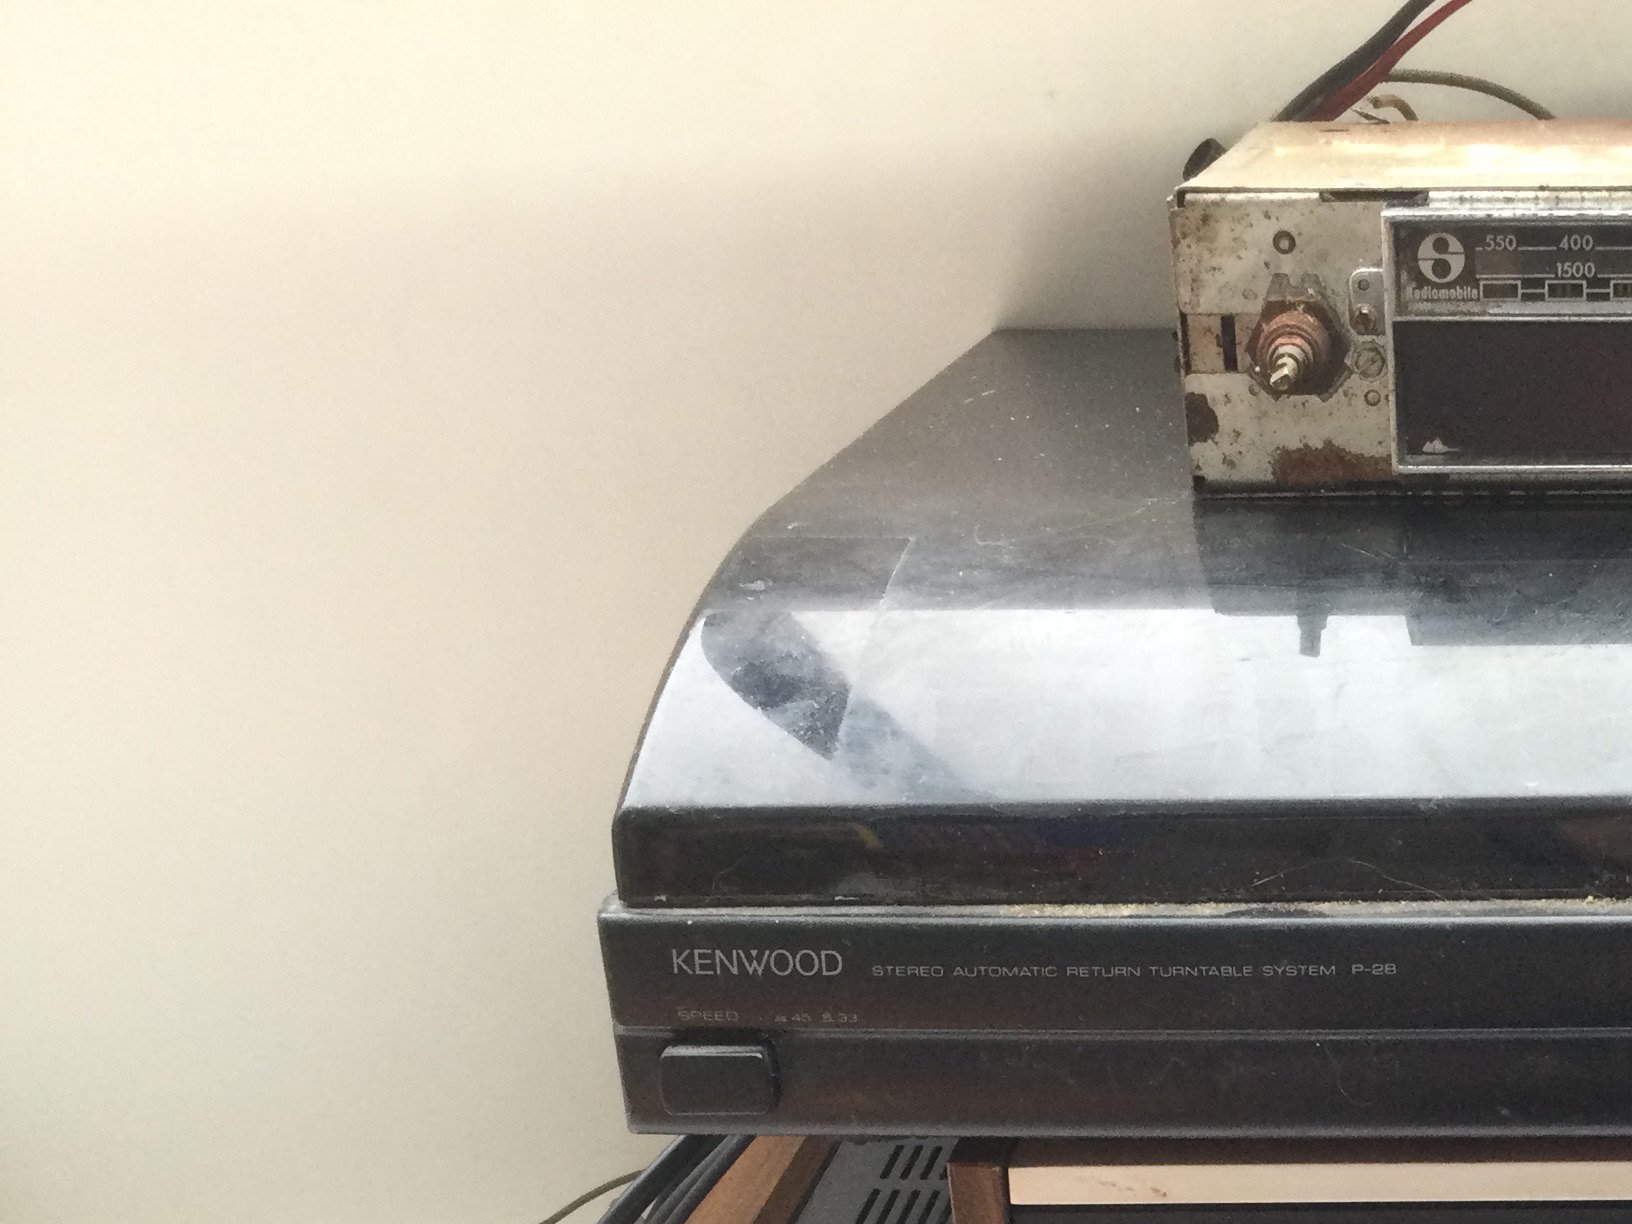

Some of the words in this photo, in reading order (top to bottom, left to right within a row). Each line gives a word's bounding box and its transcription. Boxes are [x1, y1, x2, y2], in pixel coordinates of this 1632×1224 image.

[1485, 235, 1516, 251] 550
[1559, 235, 1593, 250] 400
[1557, 262, 1595, 277] 1500
[672, 949, 842, 976] KENWOOD
[872, 966, 943, 977] STEREO
[953, 966, 1057, 977] AUTOMATIC
[1067, 967, 1140, 977] RETURN
[1149, 966, 1252, 977] TURNTABLE
[1263, 965, 1335, 976] SYSTEM
[1352, 964, 1396, 975] P-28
[678, 1011, 739, 1022] SPEED
